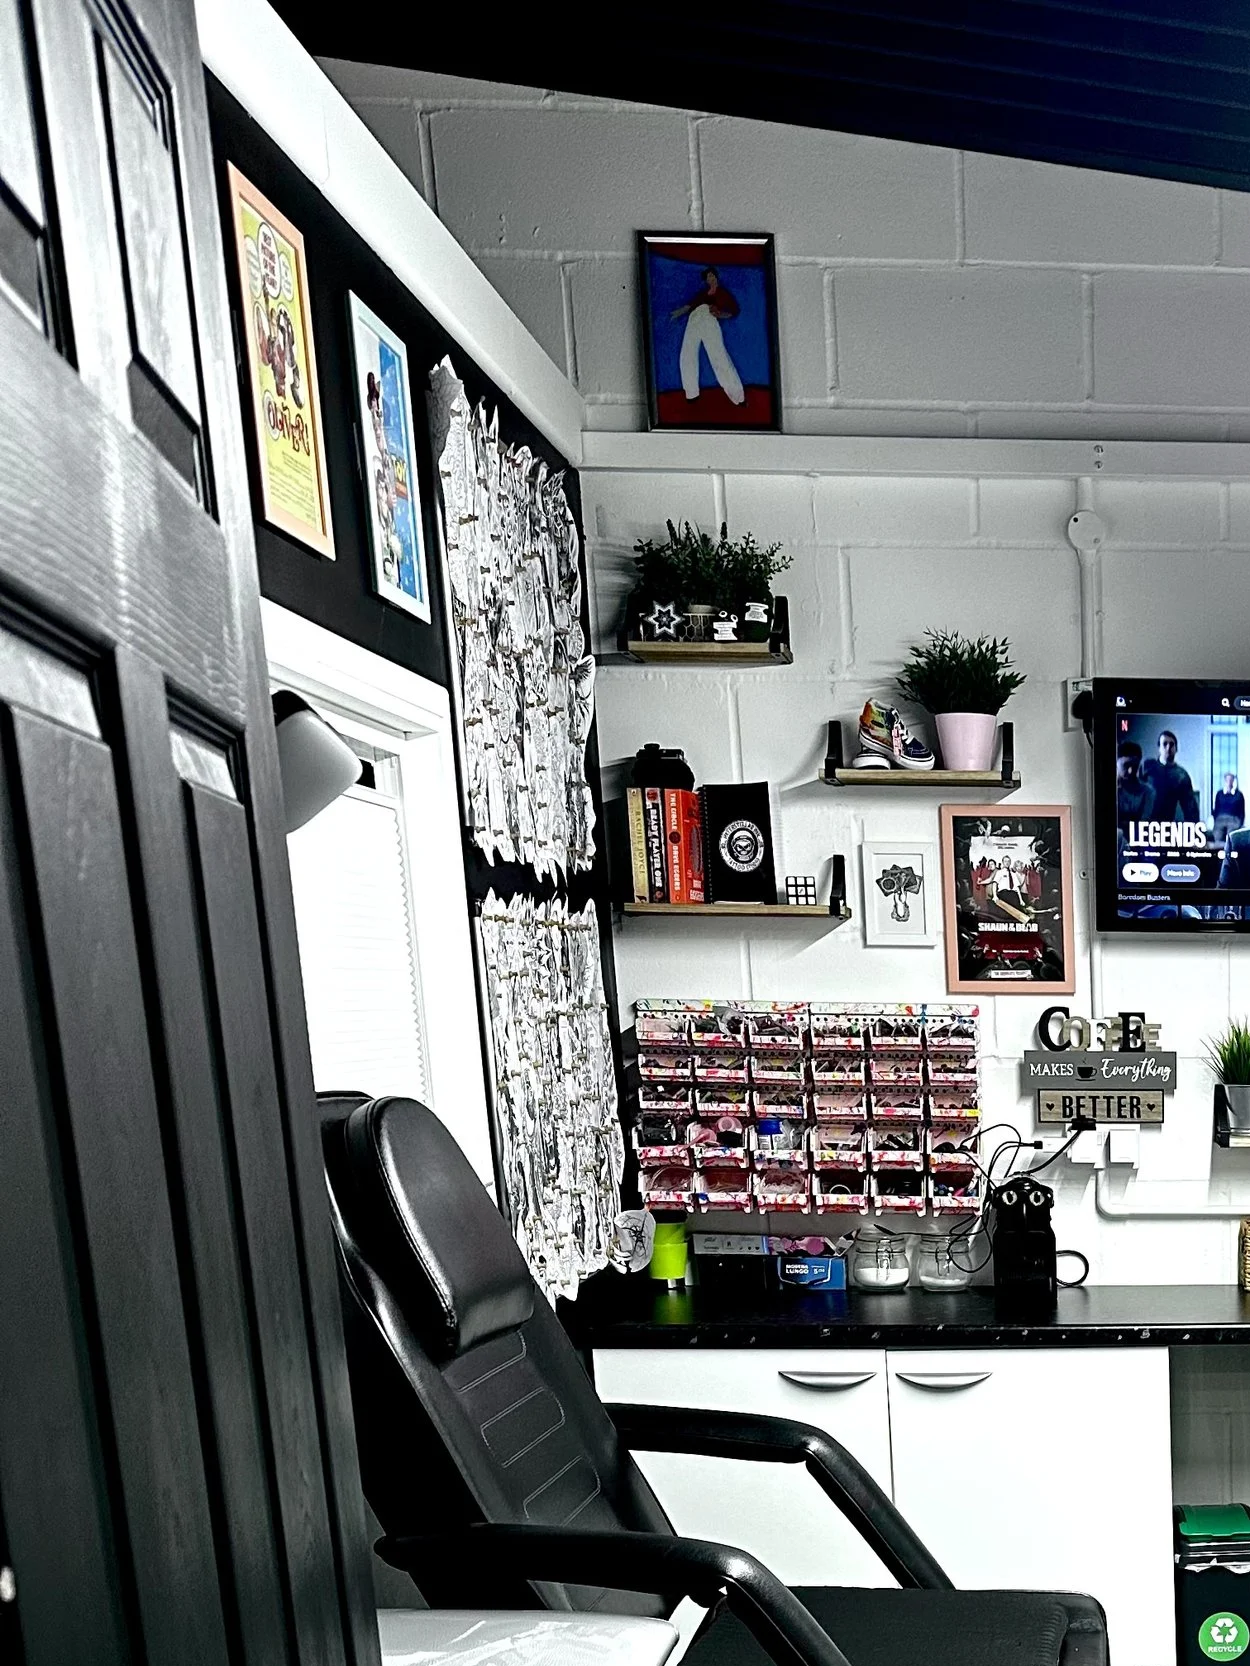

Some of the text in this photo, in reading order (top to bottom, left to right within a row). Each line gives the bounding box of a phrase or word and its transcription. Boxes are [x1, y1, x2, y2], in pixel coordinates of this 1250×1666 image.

[268, 401, 310, 456] OLIVER!
[1129, 821, 1207, 848] LEGENDS
[638, 848, 646, 874] JOYCE
[652, 838, 661, 868] PLAYER
[655, 870, 663, 887] ONE
[978, 923, 1009, 932] SHAUN
[1038, 1006, 1162, 1052] COFFEE
[1030, 1058, 1172, 1082] MAKES Everything
[1062, 1096, 1141, 1119] BETTER
